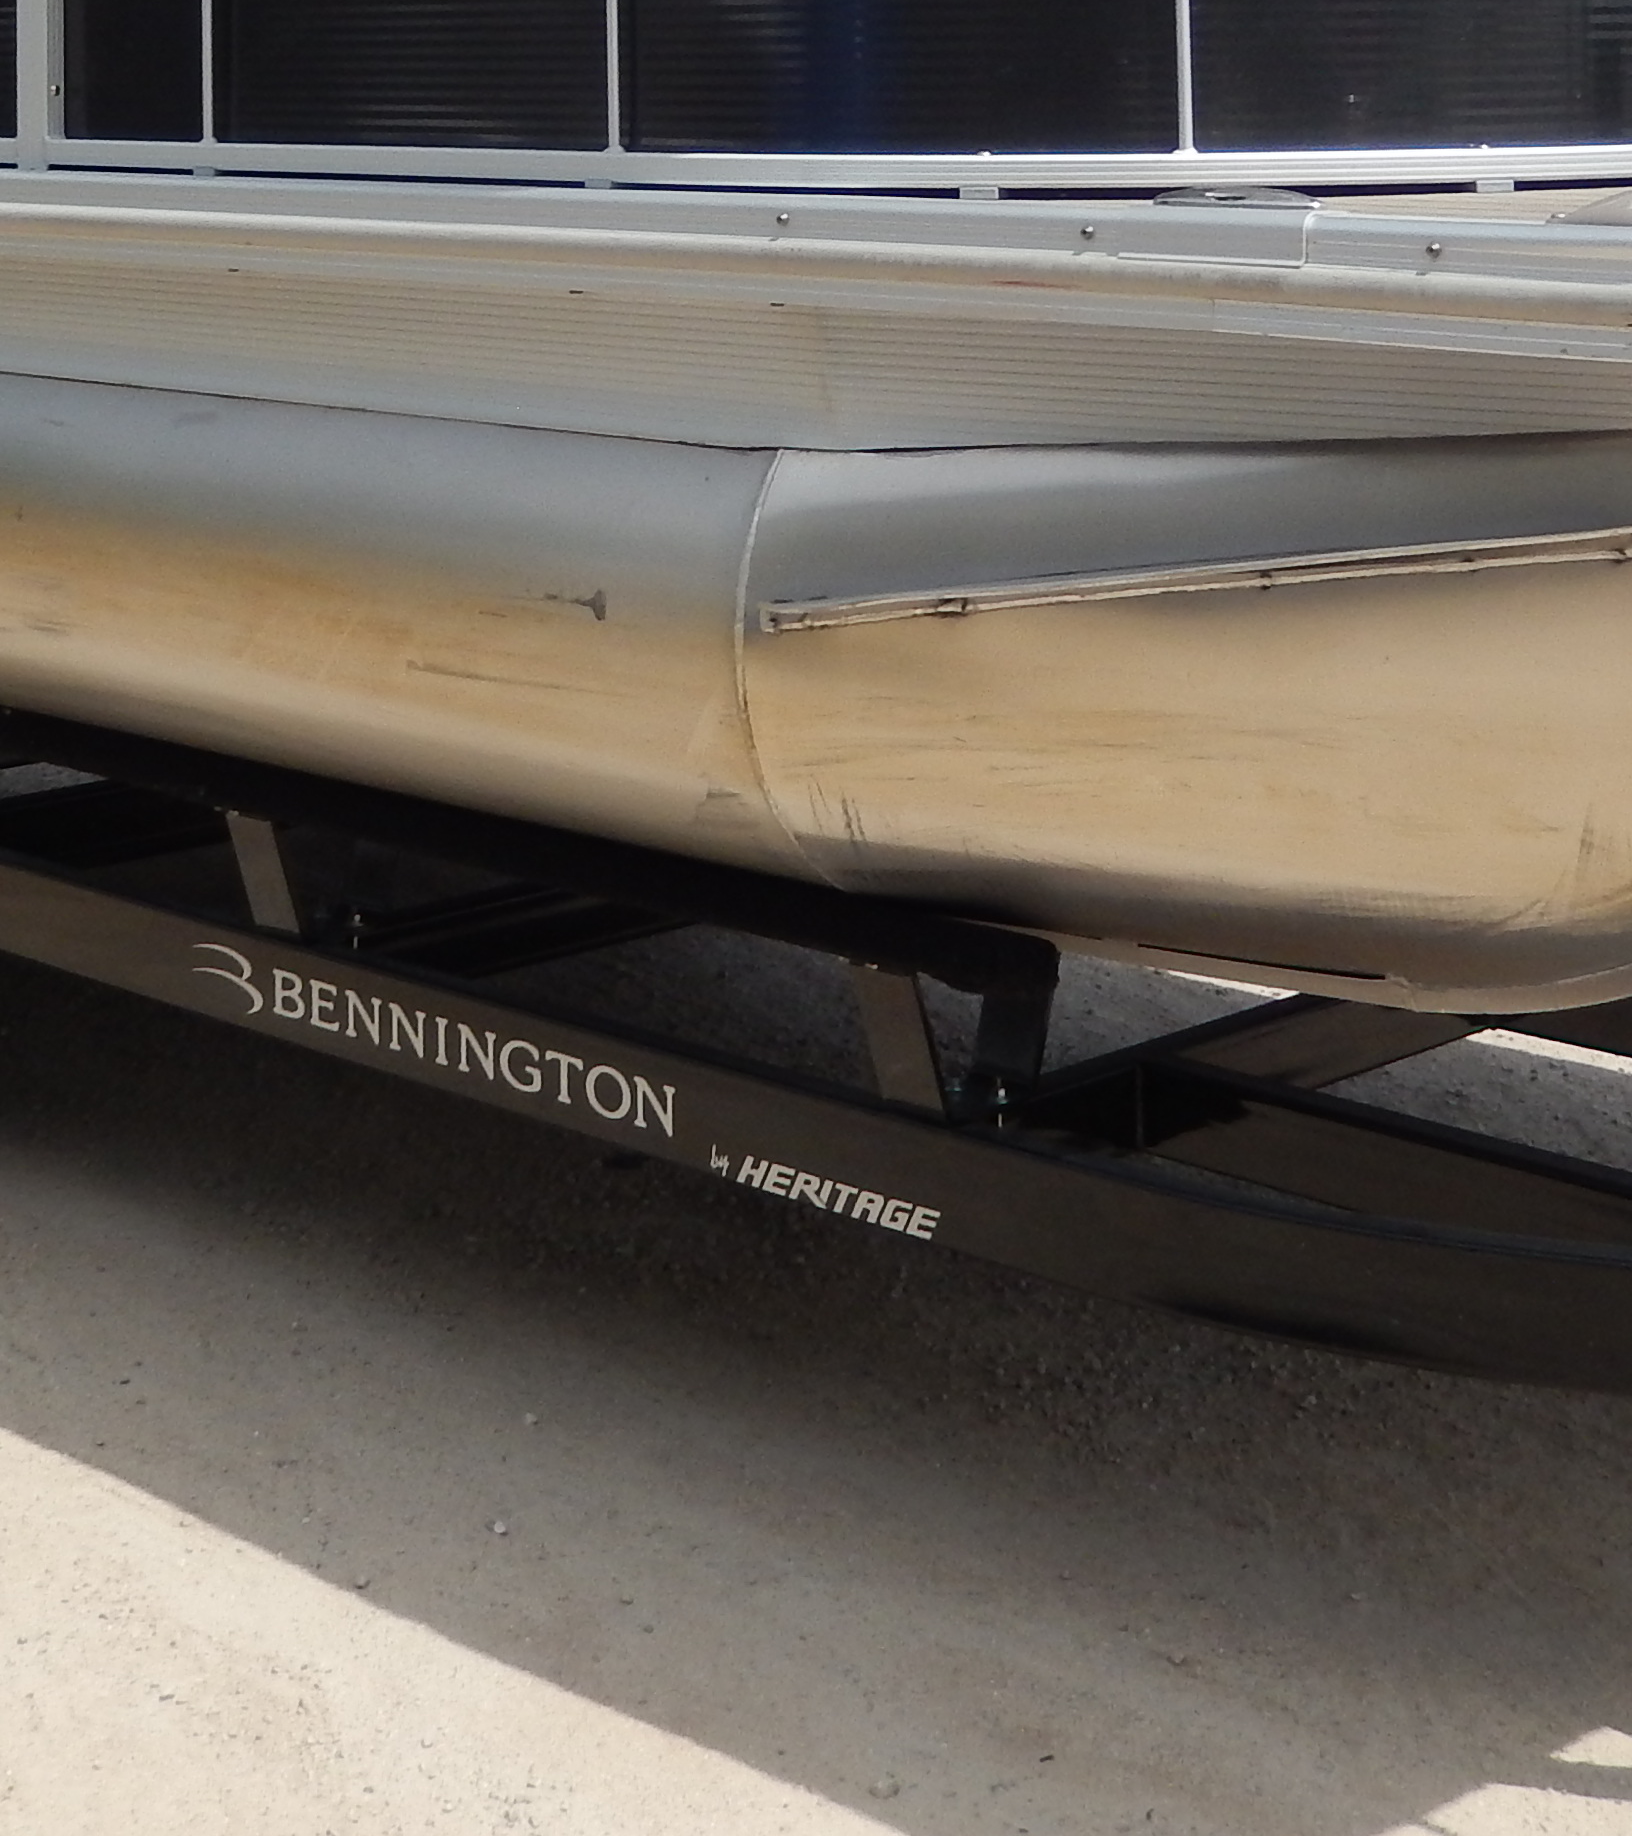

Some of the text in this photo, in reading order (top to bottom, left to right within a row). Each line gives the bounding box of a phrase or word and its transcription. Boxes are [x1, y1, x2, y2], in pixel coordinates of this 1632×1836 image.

[272, 967, 676, 1138] BENNINGTON
[710, 1145, 941, 1241] by HERITAGE
